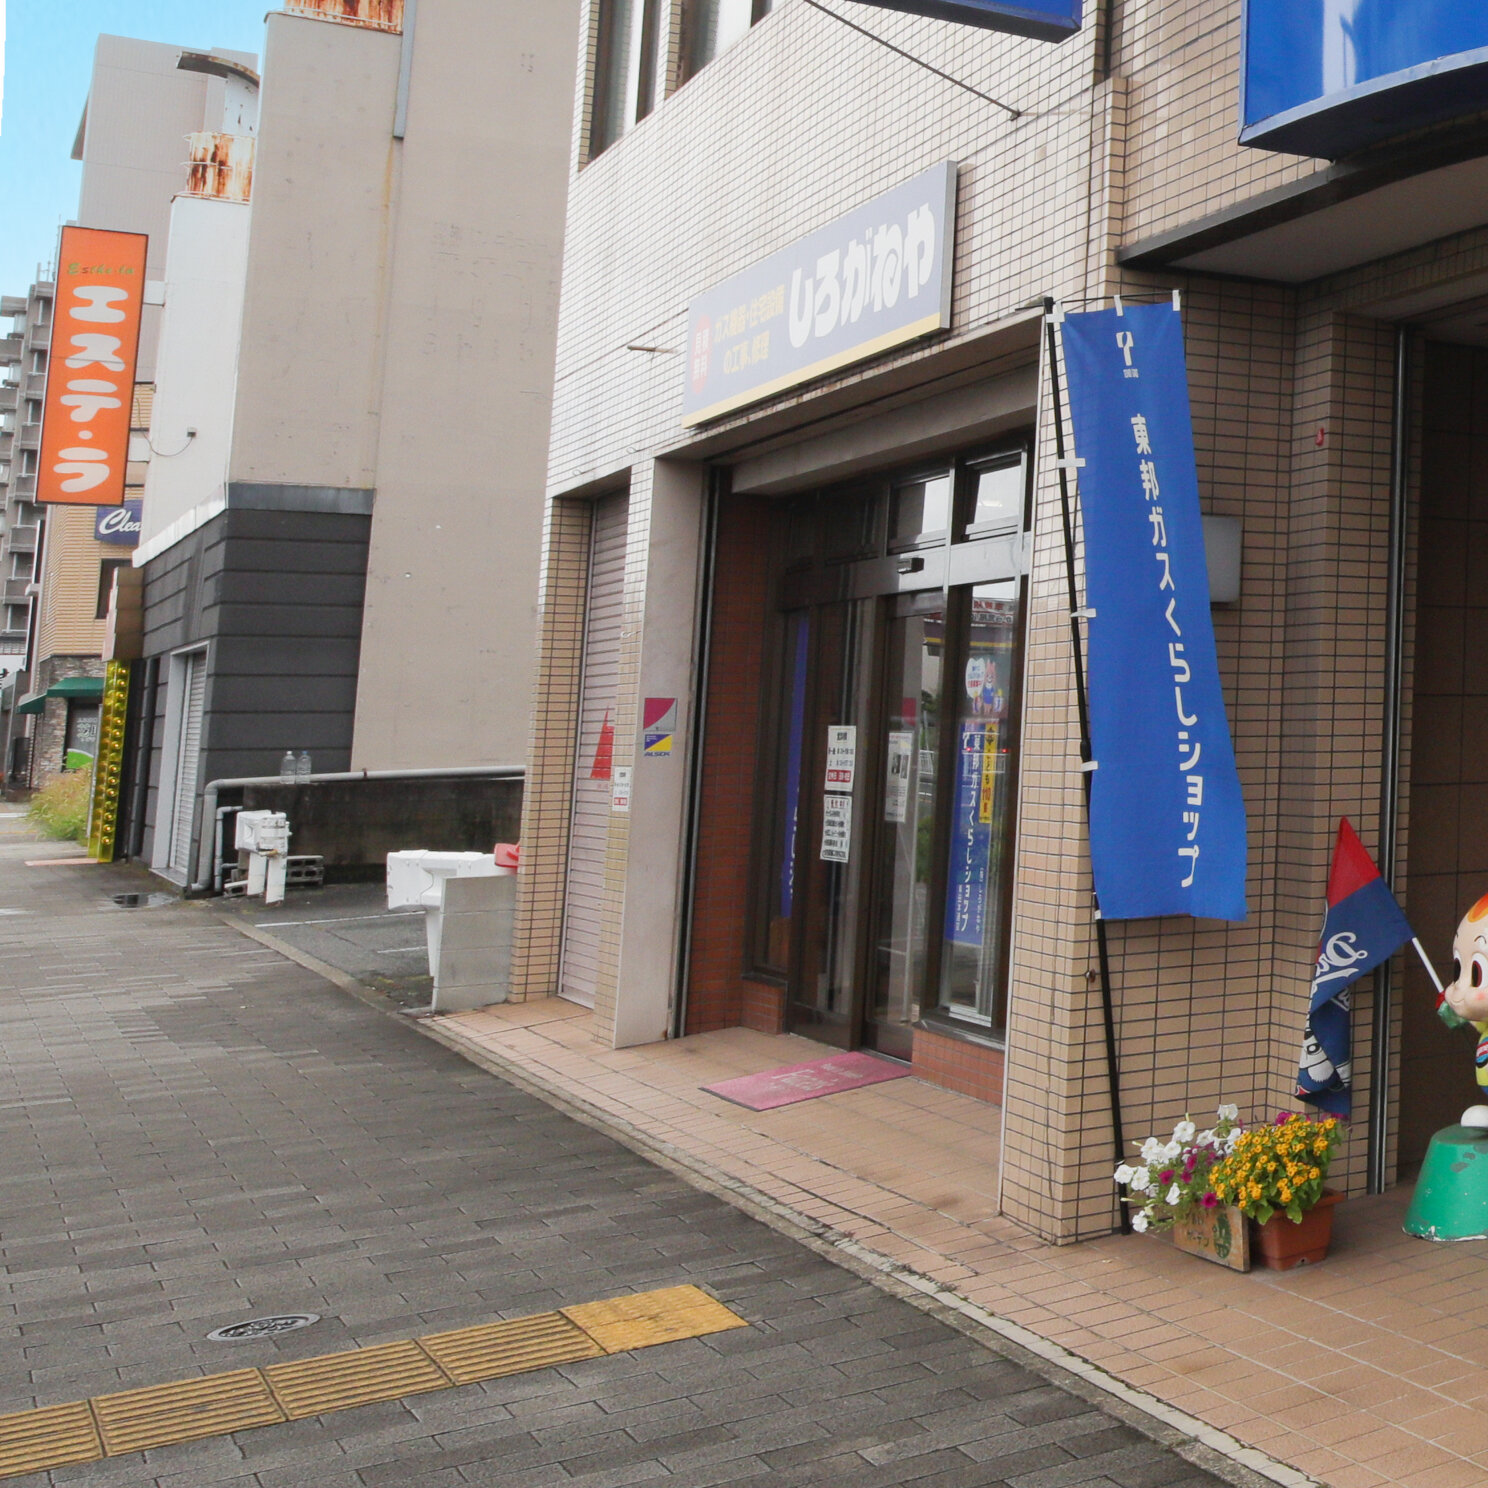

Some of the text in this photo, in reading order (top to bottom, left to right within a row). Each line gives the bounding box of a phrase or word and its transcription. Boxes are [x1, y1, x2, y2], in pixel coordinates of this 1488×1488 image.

[788, 202, 936, 349] しろがねや
[1130, 413, 1203, 888] 東邦ガスくらしショップ
